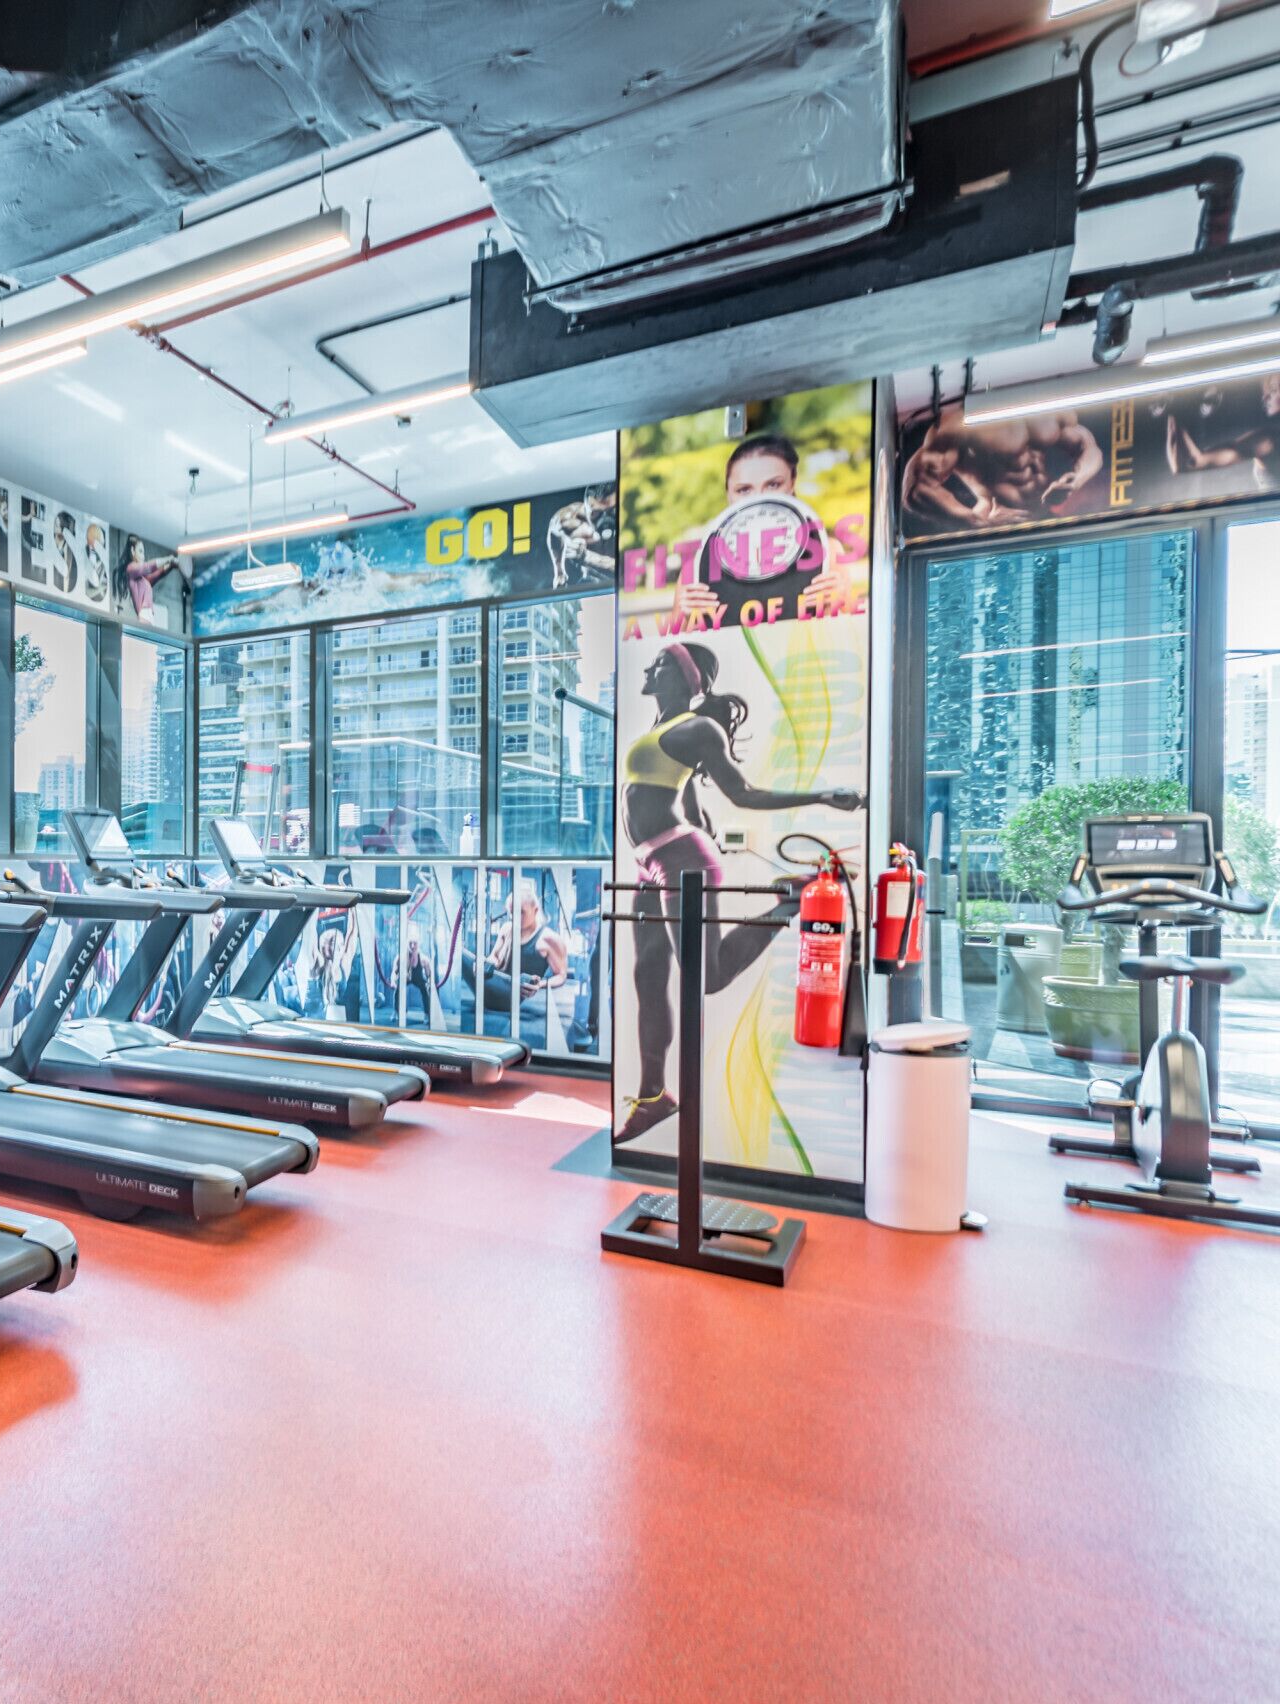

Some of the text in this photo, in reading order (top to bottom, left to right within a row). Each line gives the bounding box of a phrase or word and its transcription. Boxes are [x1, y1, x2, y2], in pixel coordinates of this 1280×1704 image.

[425, 501, 532, 566] GO!
[623, 514, 866, 593] FITNESS
[622, 615, 643, 641] A
[655, 603, 728, 636] WAY
[740, 595, 784, 628] OF
[53, 924, 103, 1009] MATRIX
[203, 917, 250, 989] MATRIX
[311, 1101, 336, 1113] DECK
[95, 1171, 179, 1199] ULTIMATE DECK
